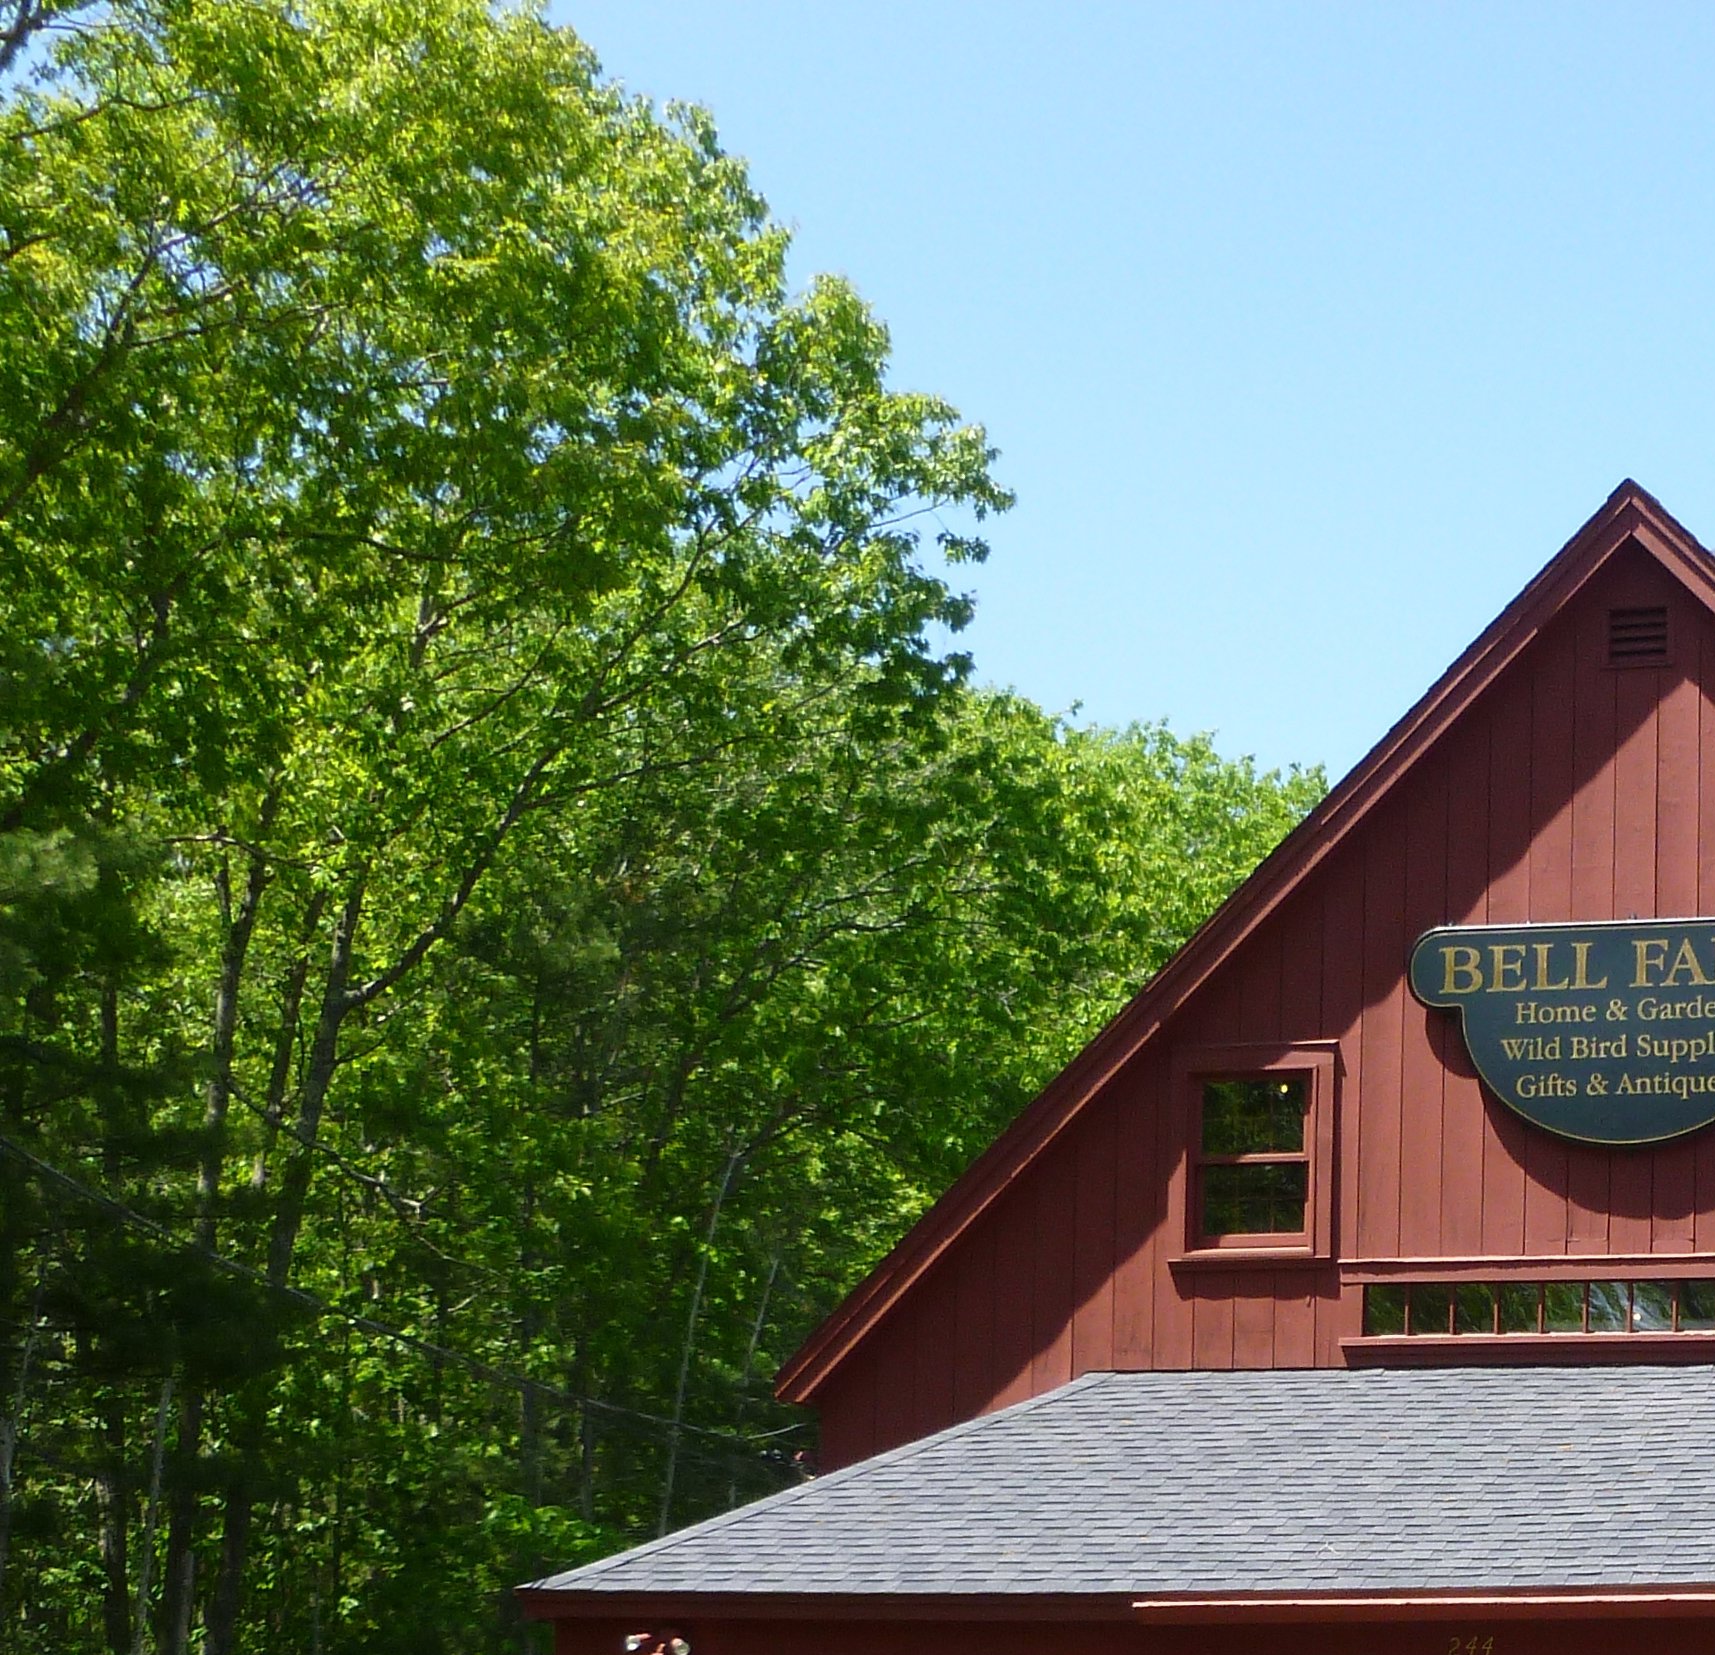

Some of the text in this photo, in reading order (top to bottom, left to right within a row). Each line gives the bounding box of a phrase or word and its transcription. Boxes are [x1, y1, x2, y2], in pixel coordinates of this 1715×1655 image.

[1438, 941, 1608, 995] BELL
[1515, 1001, 1597, 1025] Home
[1605, 998, 1629, 1022] &
[1500, 1036, 1562, 1061] Wild
[1570, 1033, 1628, 1060] Bird
[1516, 1073, 1577, 1099] Gifts
[1586, 1072, 1609, 1097] &
